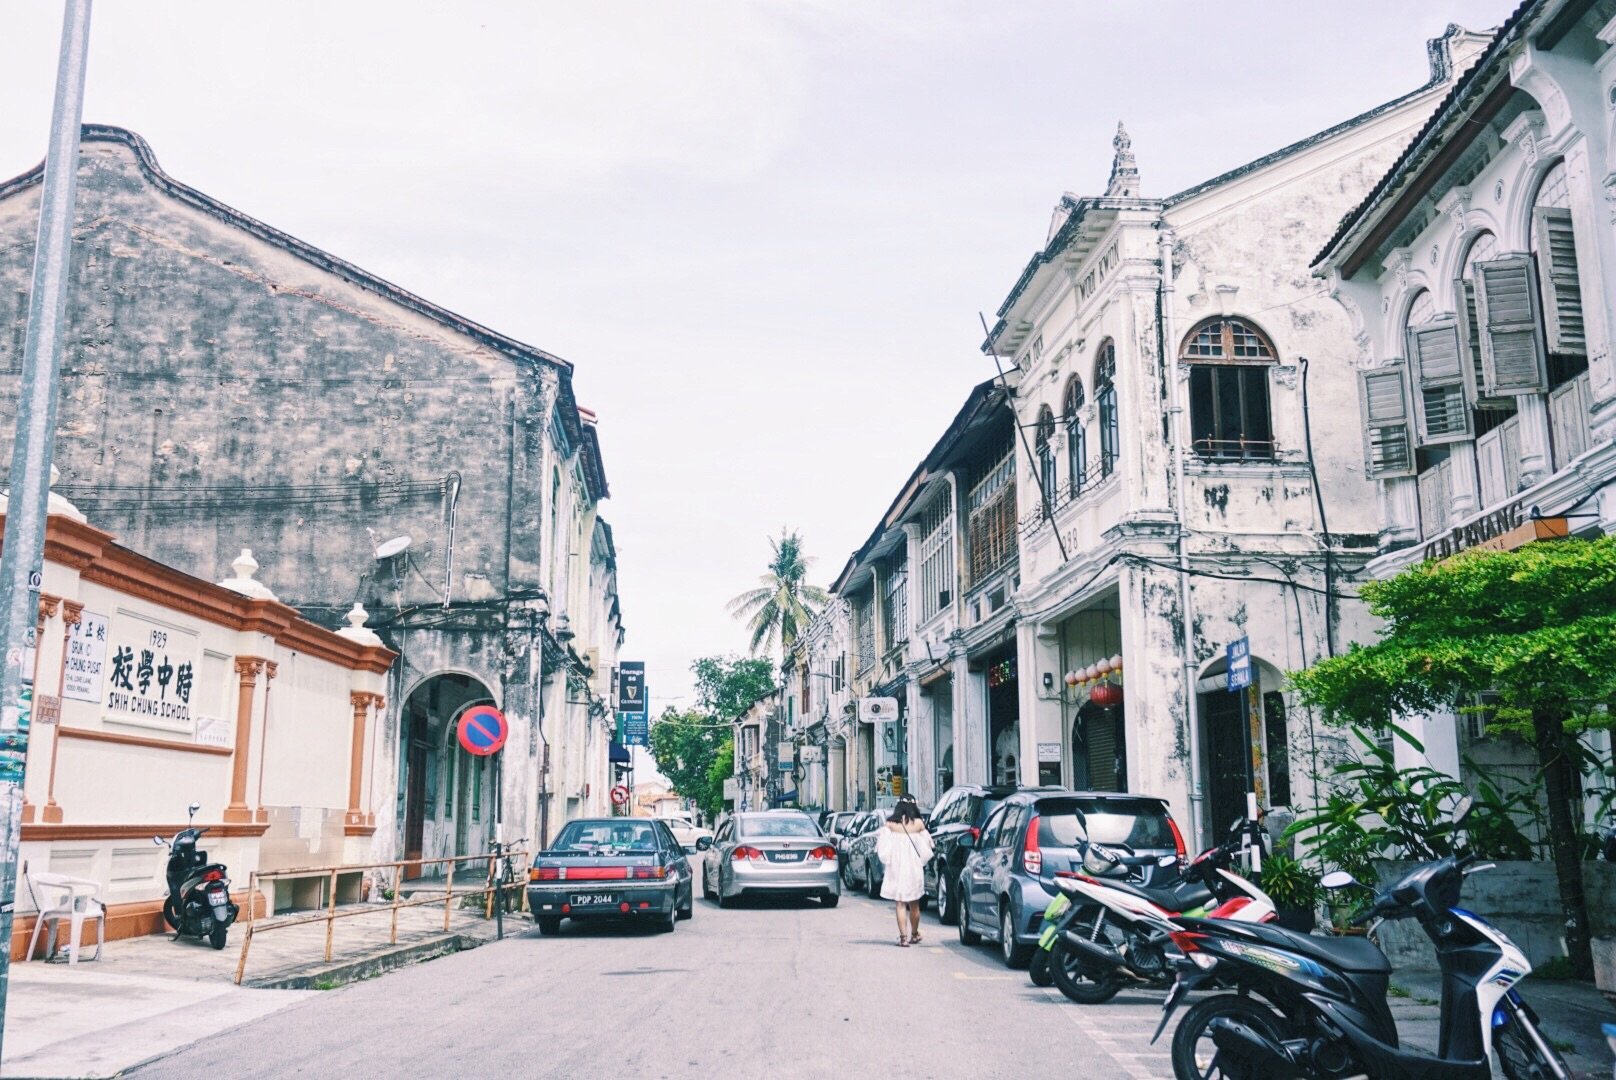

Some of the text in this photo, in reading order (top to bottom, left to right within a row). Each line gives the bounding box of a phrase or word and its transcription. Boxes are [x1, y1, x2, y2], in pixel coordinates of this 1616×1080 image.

[1452, 499, 1523, 554] PENANG
[150, 629, 168, 649] 1929
[70, 657, 86, 673] CHUNG
[87, 661, 102, 675] PUSAT
[108, 692, 191, 720] SHIH CHUNG SCHOOL
[593, 895, 612, 903] 2044
